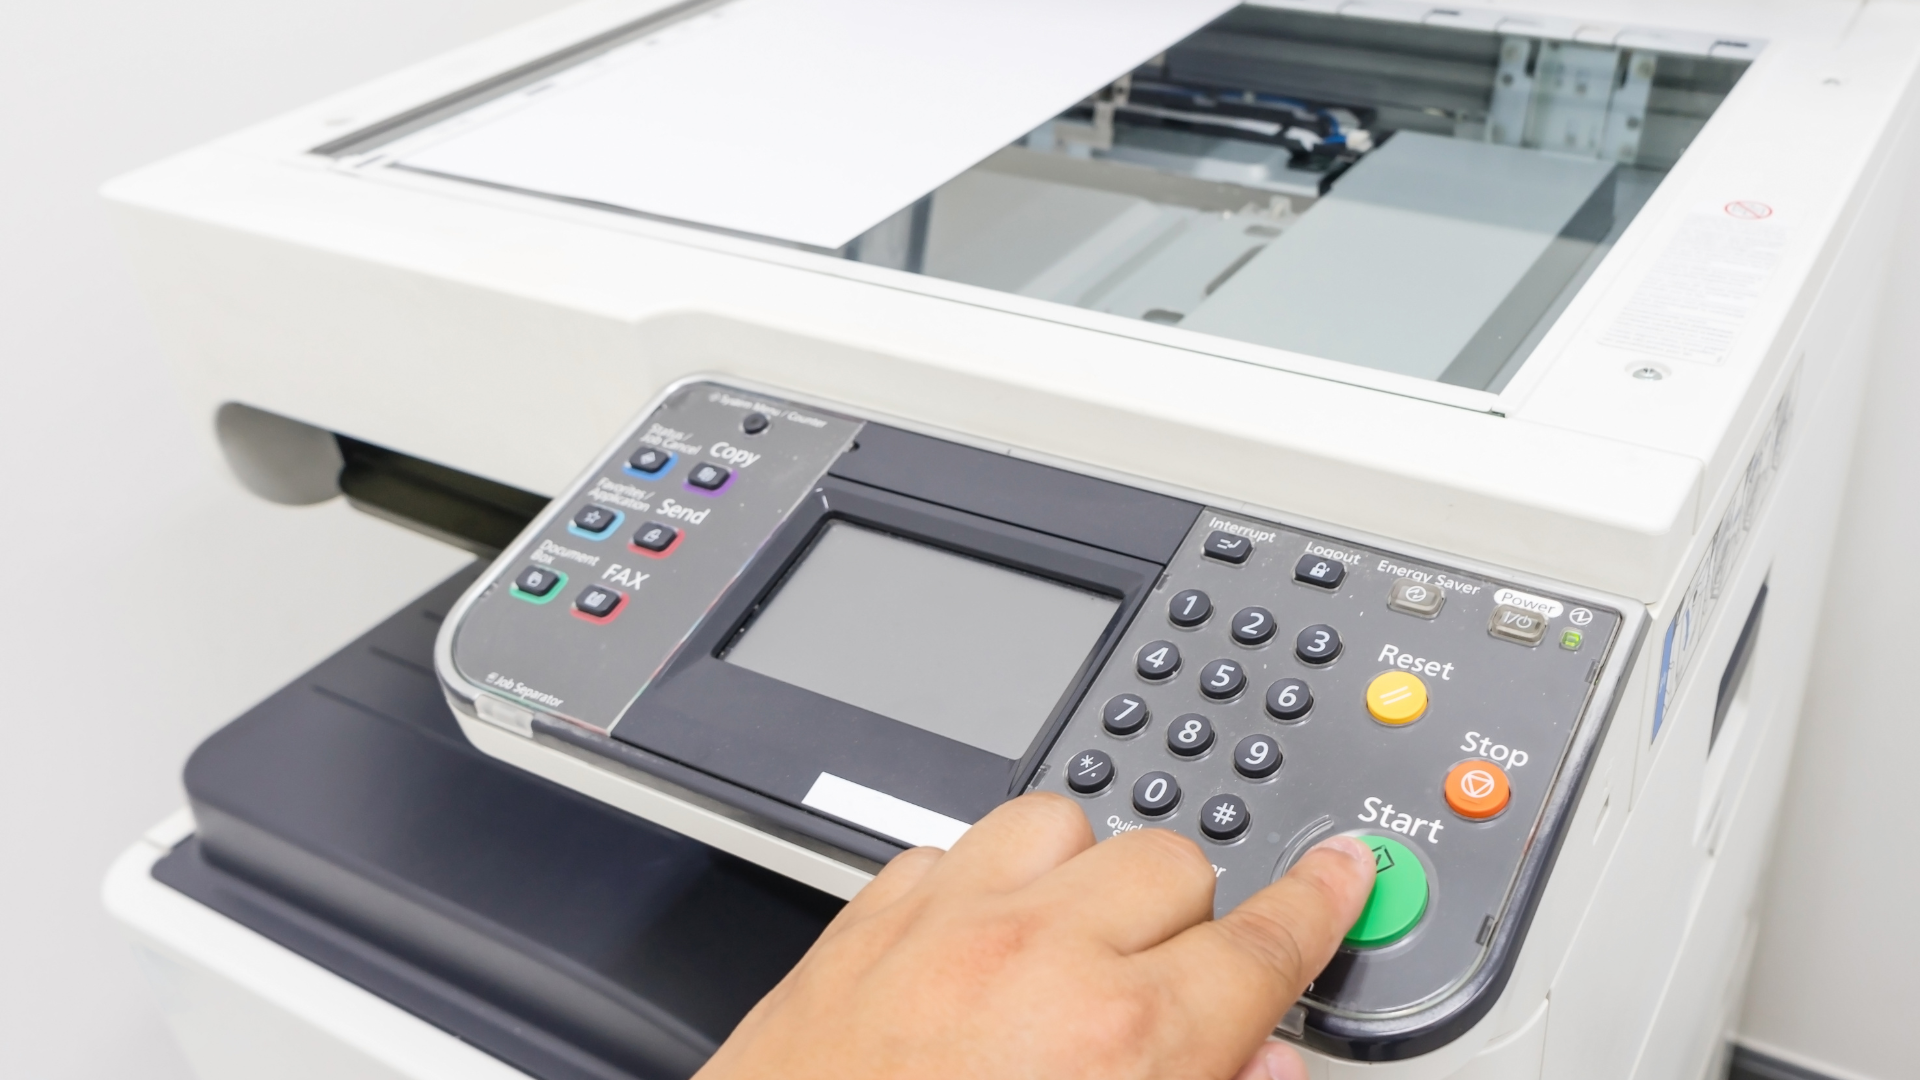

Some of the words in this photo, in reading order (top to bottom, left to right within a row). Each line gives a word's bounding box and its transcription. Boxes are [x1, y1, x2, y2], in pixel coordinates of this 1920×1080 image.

[720, 394, 753, 410] System
[751, 401, 781, 417] Menu
[787, 411, 828, 428] Counter
[640, 433, 663, 446] Job
[662, 438, 702, 456] Cancel
[709, 441, 761, 468] Copy
[587, 487, 651, 512] Application
[656, 498, 711, 525] Send
[1208, 516, 1277, 544] Interrupt
[530, 549, 556, 565] Box
[539, 539, 600, 567] Document
[1304, 541, 1362, 566] Logout
[601, 563, 650, 590] FAX
[1376, 560, 1433, 584] Energy
[1434, 573, 1481, 596] Saver
[1501, 591, 1556, 615] Power
[1183, 595, 1198, 616] 1
[1241, 612, 1265, 635] 2
[1306, 630, 1331, 653] 3
[1145, 646, 1169, 669] 4
[1210, 664, 1235, 687] 5
[1277, 685, 1299, 708] 6
[1377, 643, 1455, 681] Reset
[493, 675, 515, 690] Job
[512, 682, 564, 707] Separator
[1113, 698, 1139, 722] 7
[1177, 719, 1202, 743] 8
[1244, 741, 1269, 765] 9
[1459, 730, 1529, 770] Stop
[1144, 778, 1167, 803] 0
[1212, 802, 1237, 825] #
[1357, 796, 1445, 844] Start
